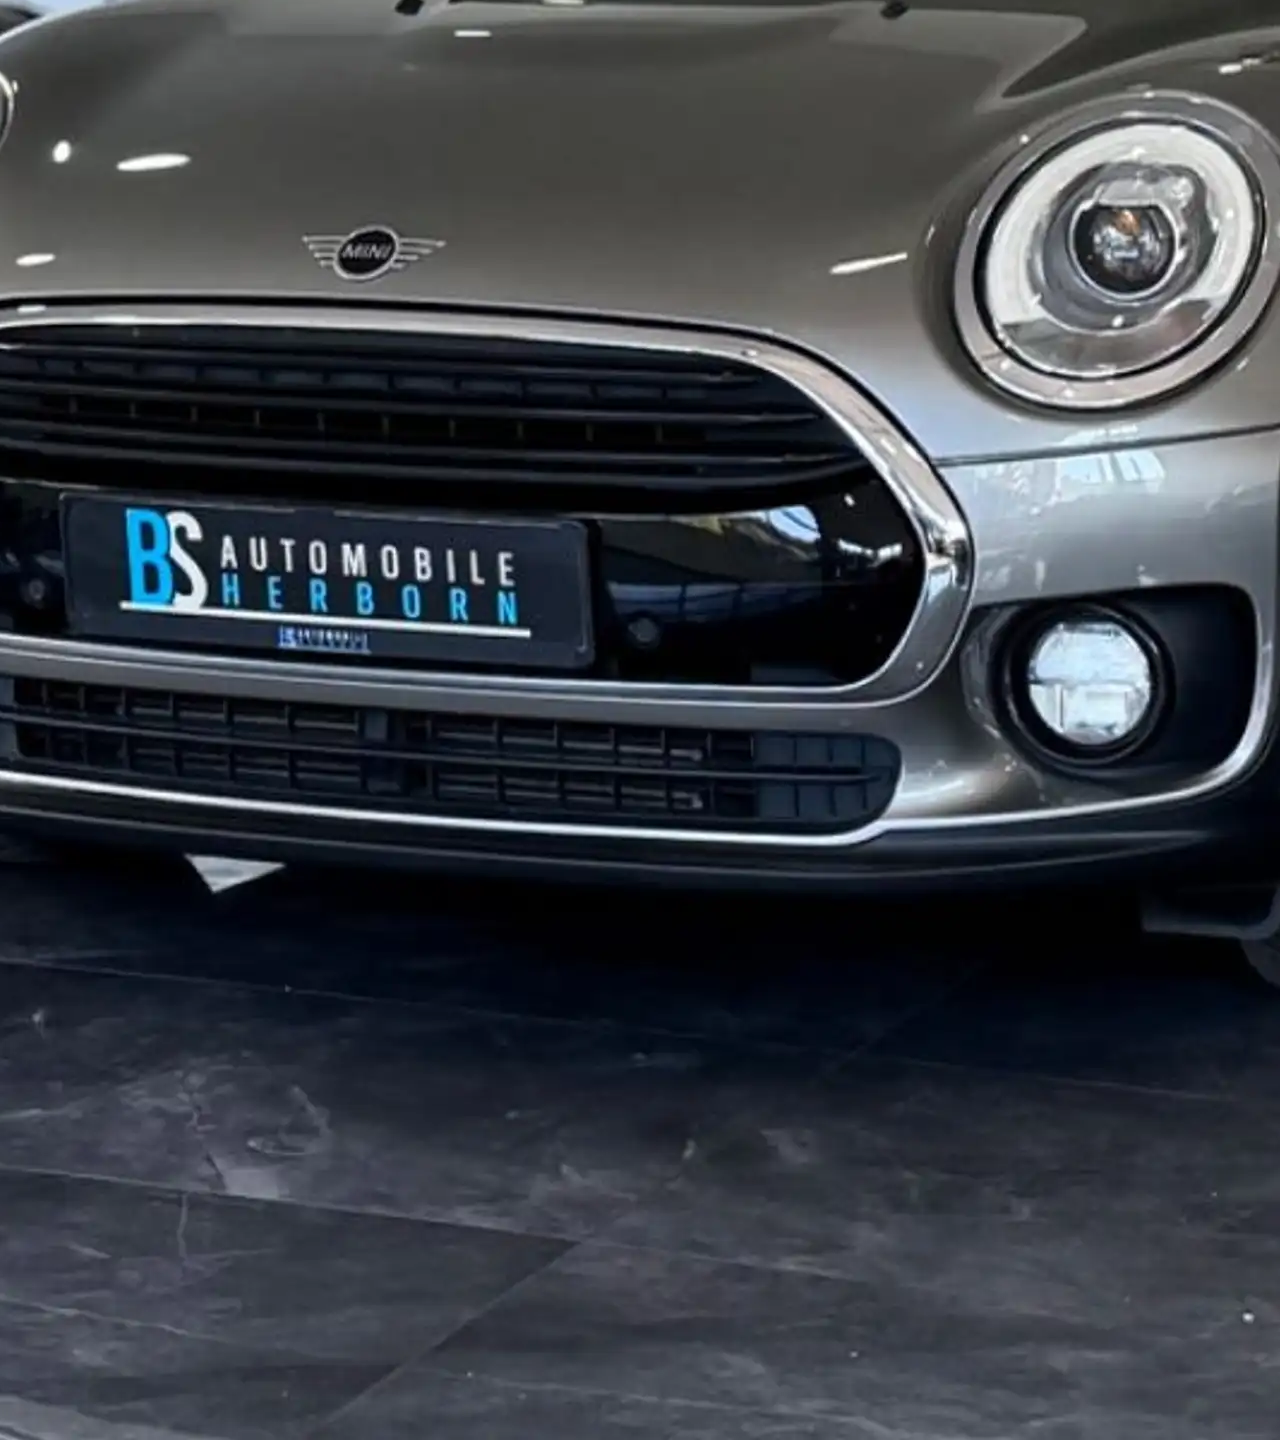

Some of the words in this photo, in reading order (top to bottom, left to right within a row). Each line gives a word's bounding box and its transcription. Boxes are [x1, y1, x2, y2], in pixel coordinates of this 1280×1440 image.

[125, 508, 209, 609] BS
[220, 535, 516, 586] AUTOMOBILE
[222, 573, 518, 625] HERBORN
